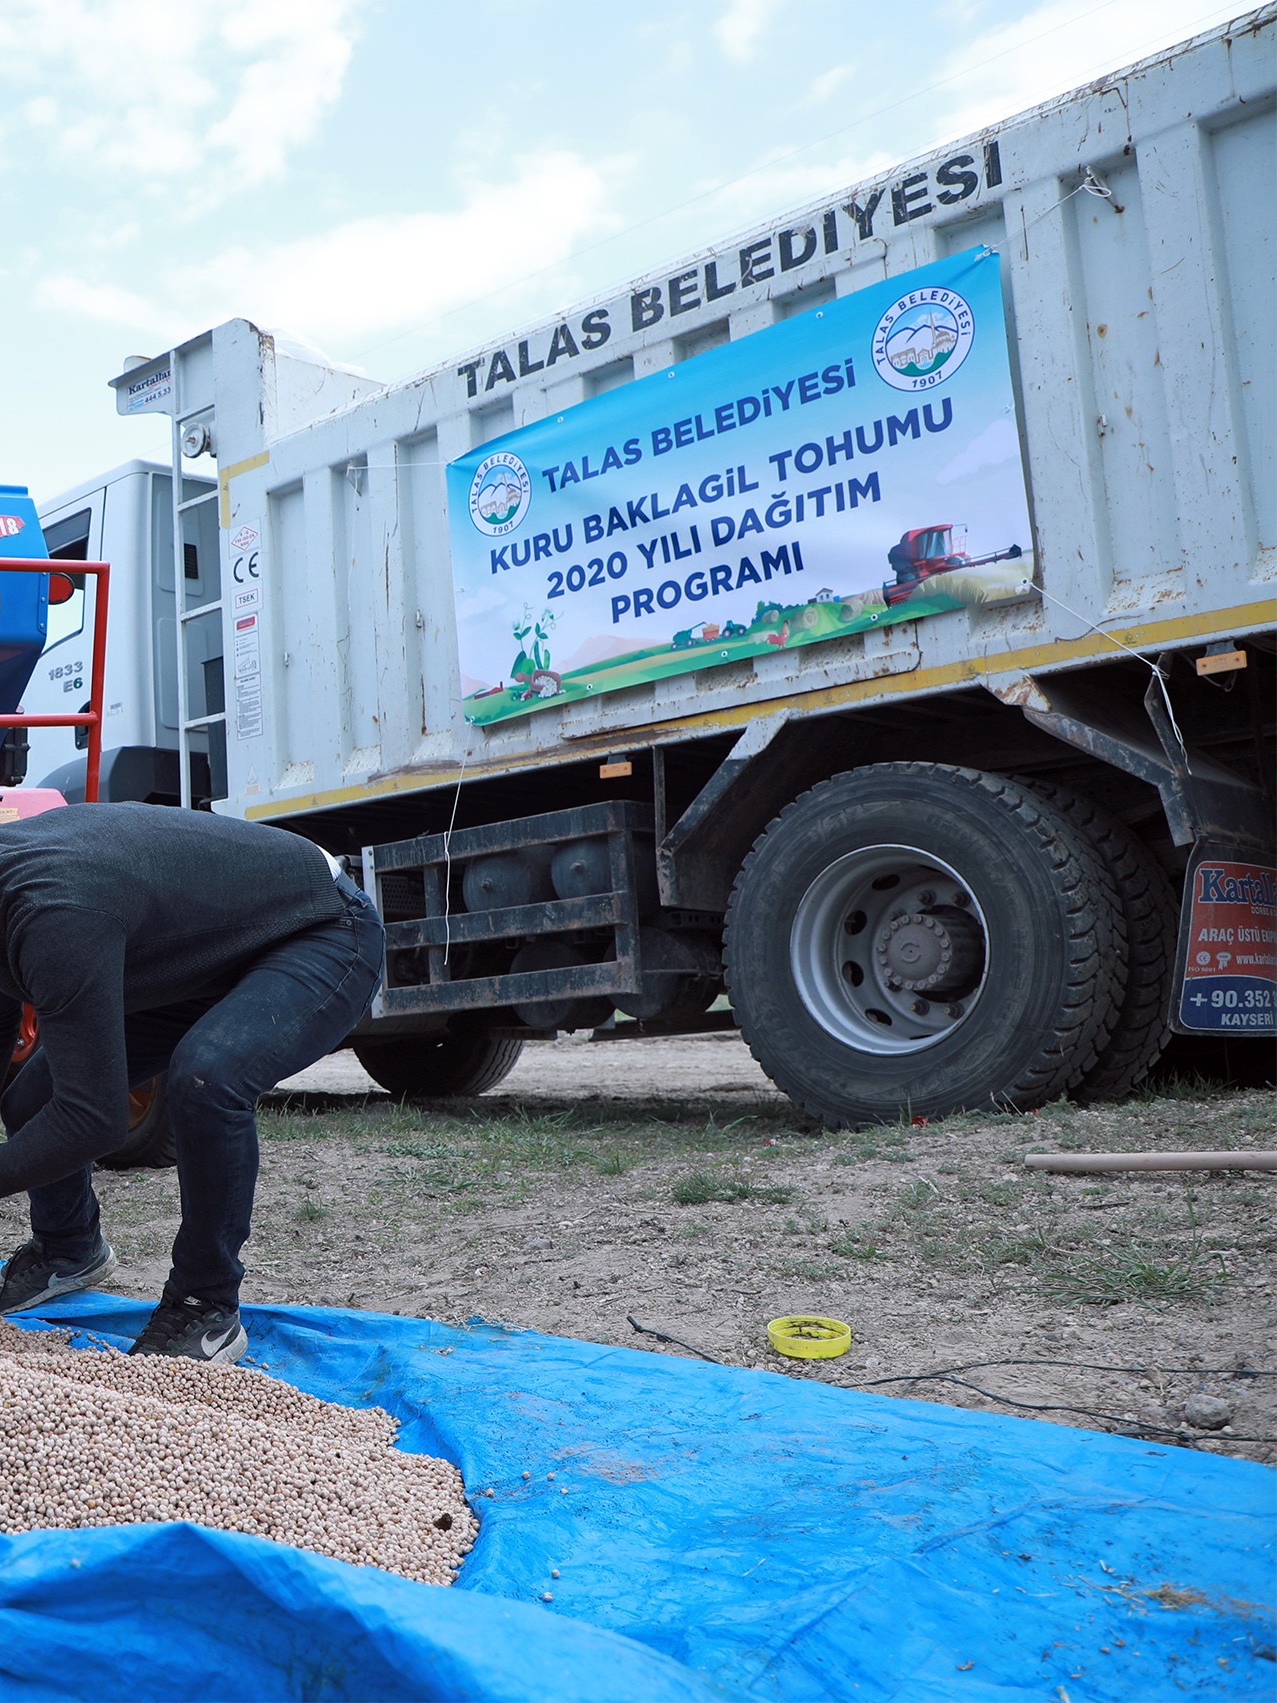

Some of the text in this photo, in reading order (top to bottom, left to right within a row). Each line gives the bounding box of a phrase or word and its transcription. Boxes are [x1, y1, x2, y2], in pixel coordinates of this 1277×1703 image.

[458, 309, 611, 398] TALAS
[875, 314, 894, 366] TALAS
[912, 370, 942, 388] 1907
[490, 523, 573, 575] KURU
[769, 397, 953, 482] TOHUMU
[542, 438, 642, 493] TALAS
[471, 472, 483, 514] TALAS
[493, 520, 514, 534] 1907
[547, 471, 882, 599] 2020 YILI DAĞITIM
[238, 593, 255, 604] TSEK
[611, 541, 804, 624] PROGRAMI
[48, 661, 83, 681] 1833
[63, 677, 83, 693] E6
[1198, 927, 1234, 945] ARAÇ
[1237, 925, 1260, 942] ÜSTÜ
